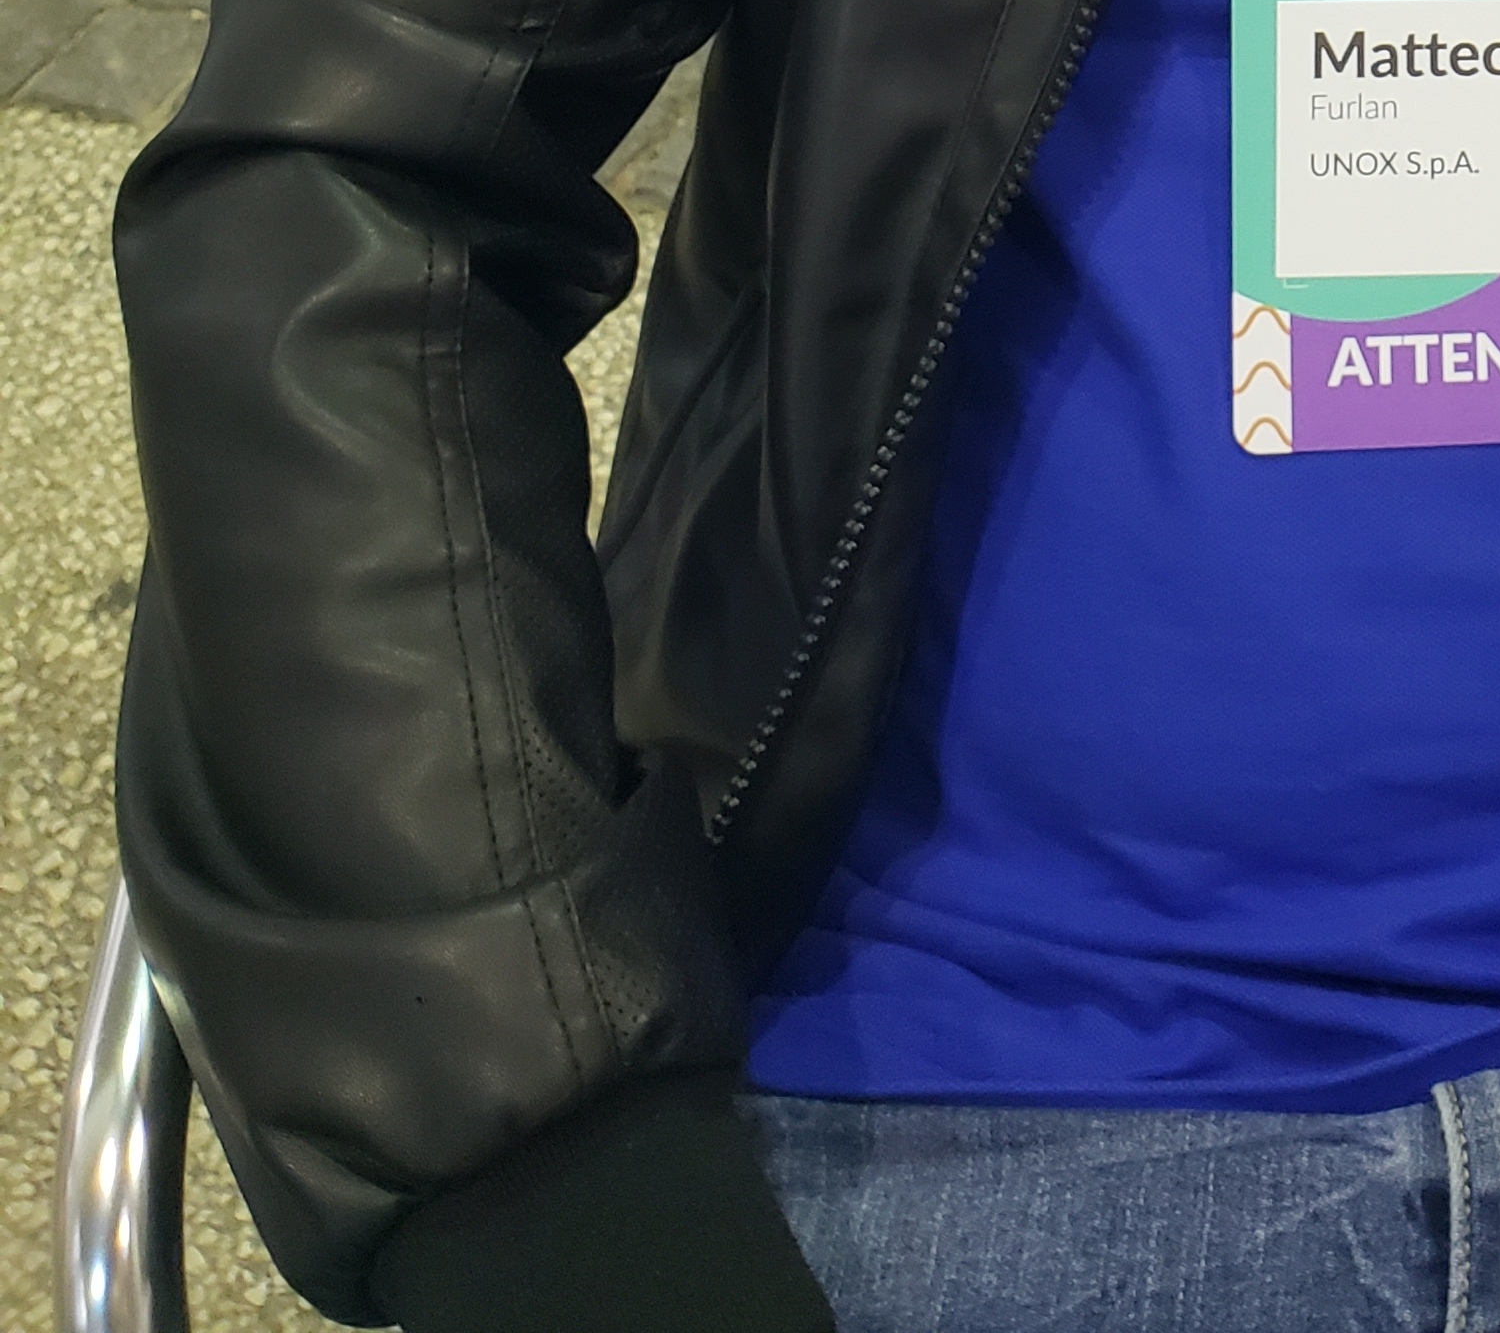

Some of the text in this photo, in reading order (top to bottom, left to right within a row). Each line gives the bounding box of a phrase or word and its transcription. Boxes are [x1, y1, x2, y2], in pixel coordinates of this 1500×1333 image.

[1310, 93, 1399, 121] Furlan
[1310, 151, 1481, 181] UNOX S.p.A.
